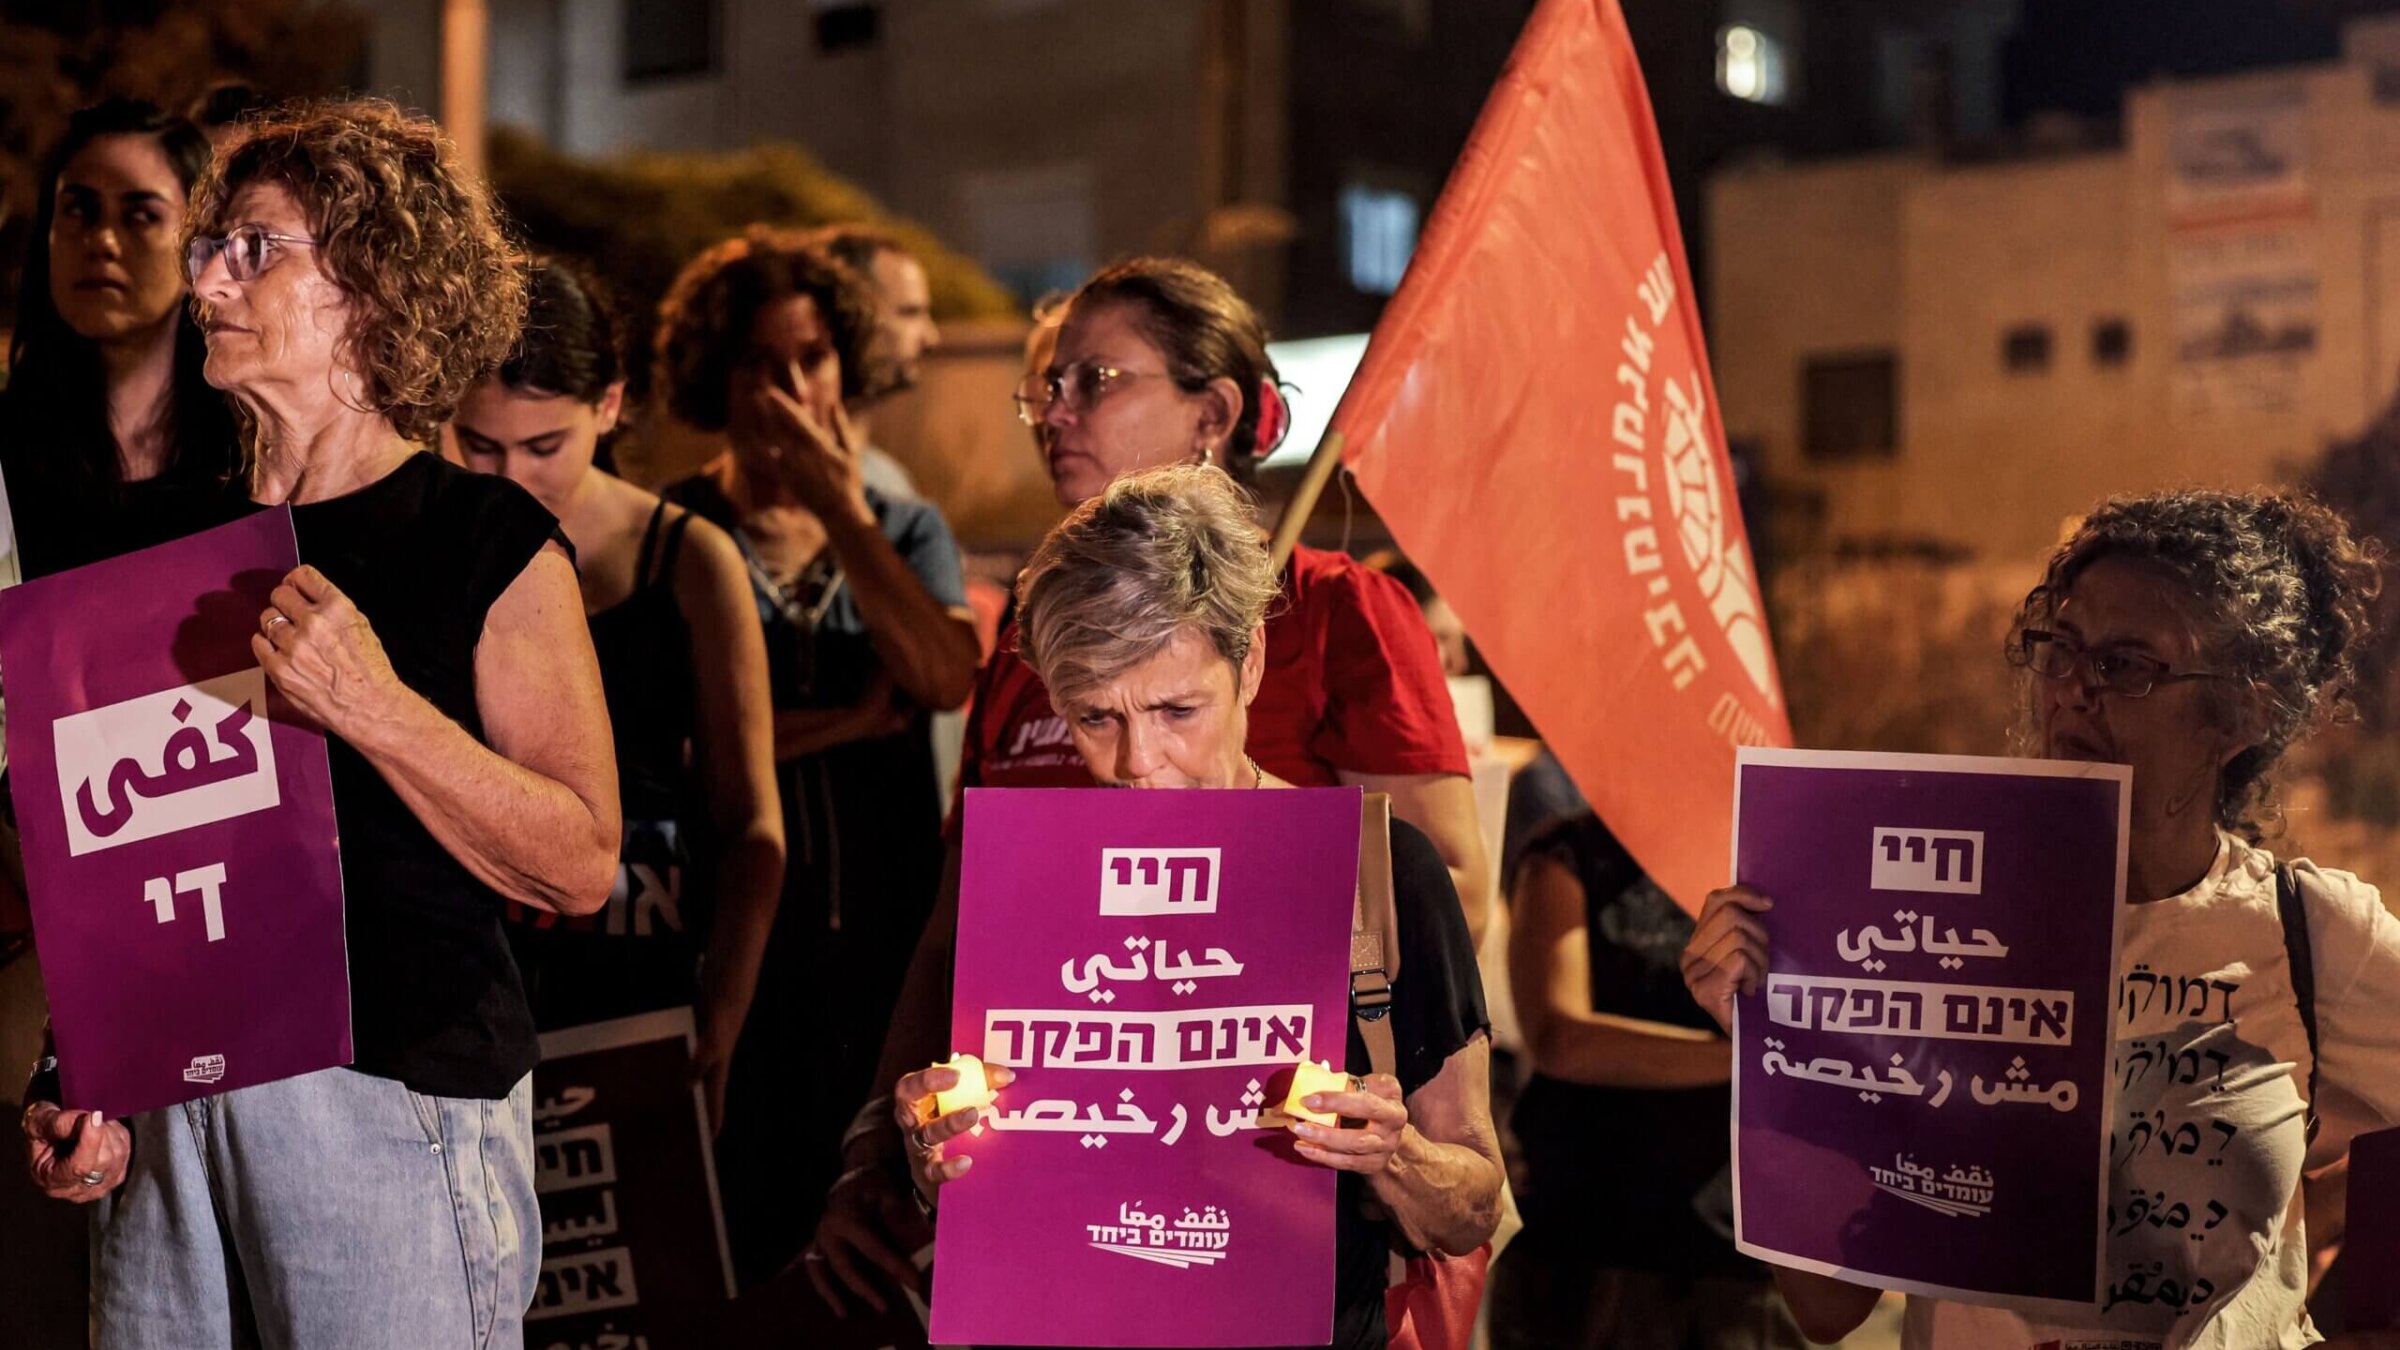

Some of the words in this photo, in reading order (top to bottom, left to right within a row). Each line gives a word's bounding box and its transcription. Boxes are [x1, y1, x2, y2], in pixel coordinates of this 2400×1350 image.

[76, 697, 259, 838] كفى
[1109, 856, 1211, 902] חיי
[1879, 834, 1975, 883] חיי
[144, 862, 227, 942] די
[1836, 909, 2009, 973] حياتي
[1061, 936, 1244, 1004] حياتي
[1772, 984, 1924, 1031] הפקר
[1943, 993, 2069, 1040] אינם
[991, 1020, 1155, 1067] הפקר
[1175, 1014, 1307, 1062] אינם
[1762, 1036, 1953, 1108] رخيصة
[1971, 1055, 2079, 1112] مش
[1205, 1078, 1290, 1137] ش
[1870, 1166, 1916, 1191] ביחד
[1921, 1179, 1994, 1204] עומדים
[1942, 1163, 1994, 1188] نقف
[1086, 1224, 1142, 1245] ביחד
[1149, 1229, 1230, 1250] עומדים
[1174, 1205, 1230, 1230] نقف
[532, 1260, 622, 1308] אינ
